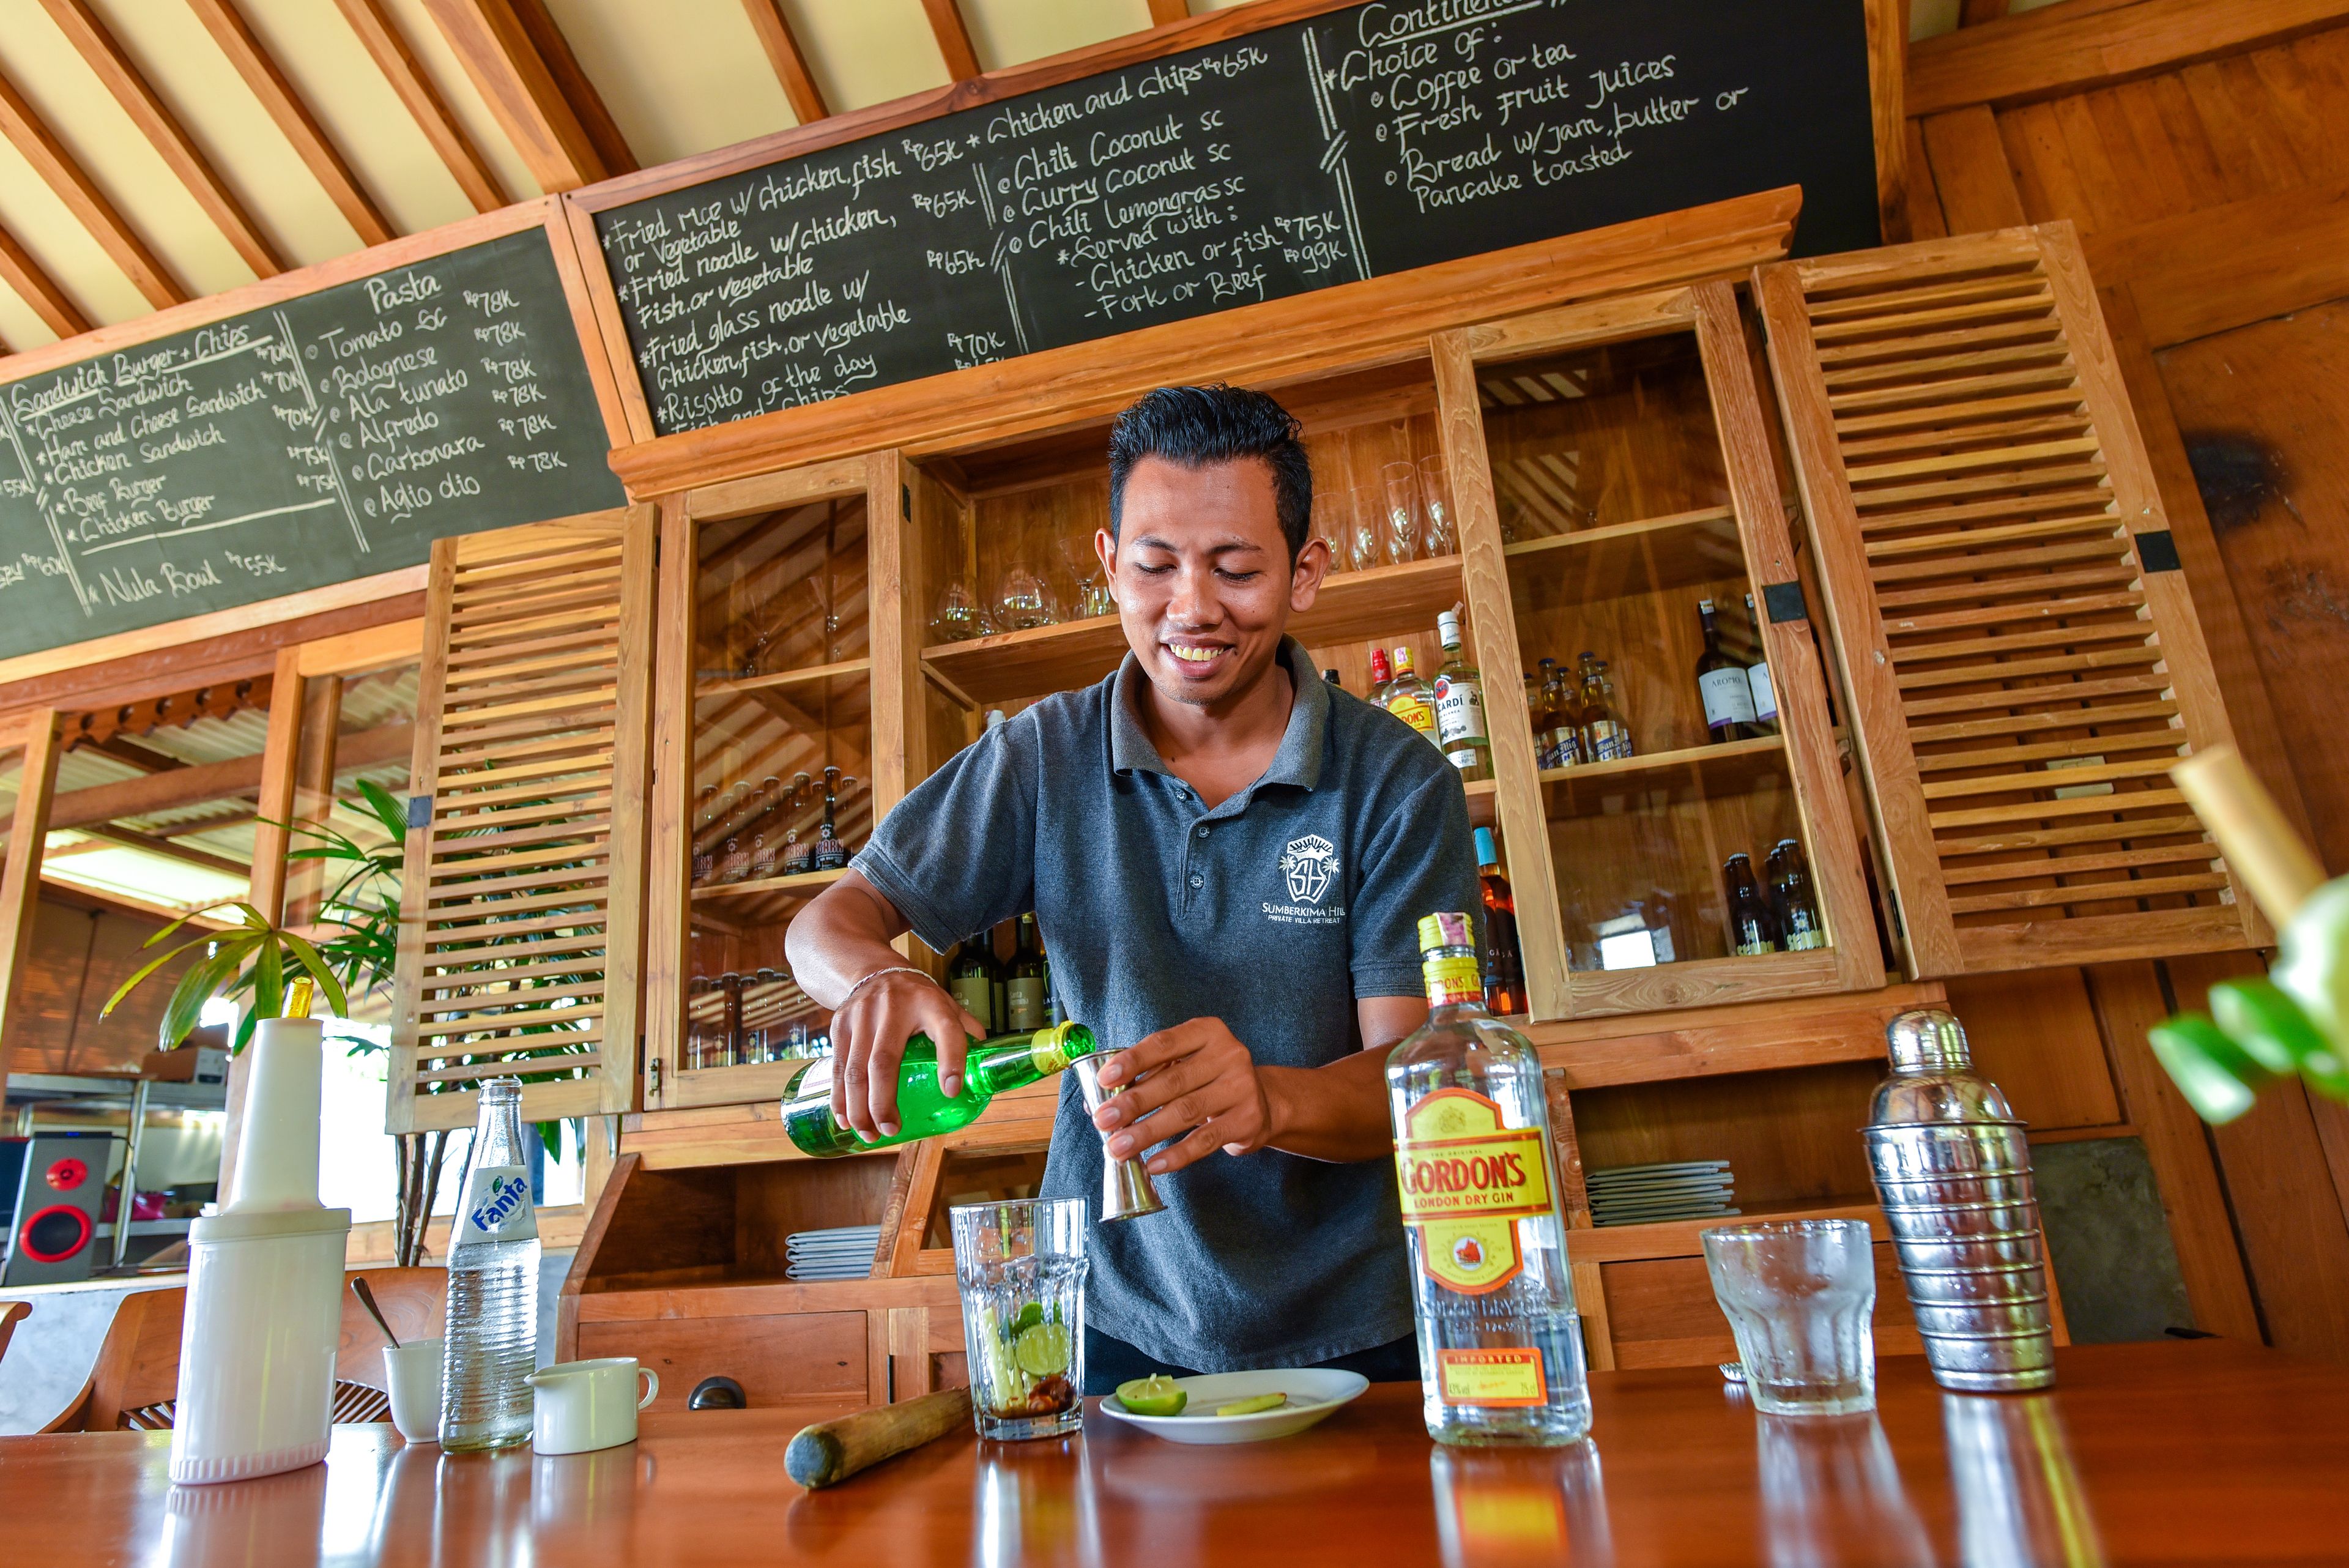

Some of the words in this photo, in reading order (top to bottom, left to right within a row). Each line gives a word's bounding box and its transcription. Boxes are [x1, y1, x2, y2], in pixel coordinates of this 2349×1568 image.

[1340, 42, 1438, 91] Choice
[1390, 65, 1482, 111] Coffee
[1493, 57, 1526, 80] or
[1532, 43, 1576, 71] tea
[987, 106, 1083, 144] Chicken
[1085, 76, 1133, 110] and
[1138, 66, 1202, 96] Chips
[1393, 96, 1482, 155] Fresh
[1496, 75, 1570, 126] Fruit
[1014, 142, 1077, 190] Chili
[1090, 114, 1183, 167] Coconut
[1401, 132, 1502, 192] Bread
[1715, 87, 1749, 111] or
[1532, 142, 1633, 185] toasted
[1022, 177, 1100, 216] Curry
[1105, 148, 1197, 193] Coconut
[611, 209, 672, 255] Fried
[678, 200, 722, 229] rice
[1028, 211, 1093, 249] Chili
[1071, 225, 1158, 267] Served
[625, 252, 645, 273] or
[628, 259, 690, 307] Fried
[697, 239, 759, 275] noodle
[1091, 251, 1196, 292] Chicken
[1202, 242, 1226, 261] or
[1230, 225, 1284, 267] fish
[364, 271, 442, 314] Pasta
[1173, 281, 1200, 303] or
[1205, 264, 1267, 305] Beef
[318, 321, 403, 360] Tomato
[646, 319, 702, 367] Fried
[697, 311, 760, 360] glass
[768, 280, 833, 323] noodle
[12, 362, 108, 427] Sandwich
[114, 349, 176, 388] Burger
[195, 324, 249, 360] Chips
[333, 347, 438, 398] Bolognese
[663, 385, 743, 423] Risotto
[785, 359, 821, 388] the
[834, 354, 878, 385] day
[35, 404, 95, 440] Cheese
[98, 371, 195, 418] Sandwich
[44, 435, 89, 467] Ham
[95, 422, 128, 450] and
[131, 410, 182, 440] Cheese
[187, 378, 268, 418] Sandwich
[349, 393, 391, 422] Ala
[360, 406, 439, 452] Alfredo
[54, 452, 132, 485] Chicken
[139, 423, 226, 463] Sandwich
[367, 436, 486, 481] Carbonara
[64, 488, 108, 518] Beef
[109, 475, 167, 508] Burger
[80, 507, 156, 543] Chicken
[157, 495, 215, 527] Burger
[380, 481, 432, 524] Aglio
[160, 559, 222, 598] Bowl
[1401, 711, 1425, 724] DON'S
[1438, 694, 1463, 713] CARDÍ
[1401, 1151, 1526, 1195] GORDON'S
[471, 1177, 527, 1231] Fanta
[1414, 1196, 1460, 1209] LONDON
[1465, 1194, 1488, 1205] DRY
[1492, 1192, 1514, 1203] GIN
[1454, 1354, 1523, 1364] IMPORTED
